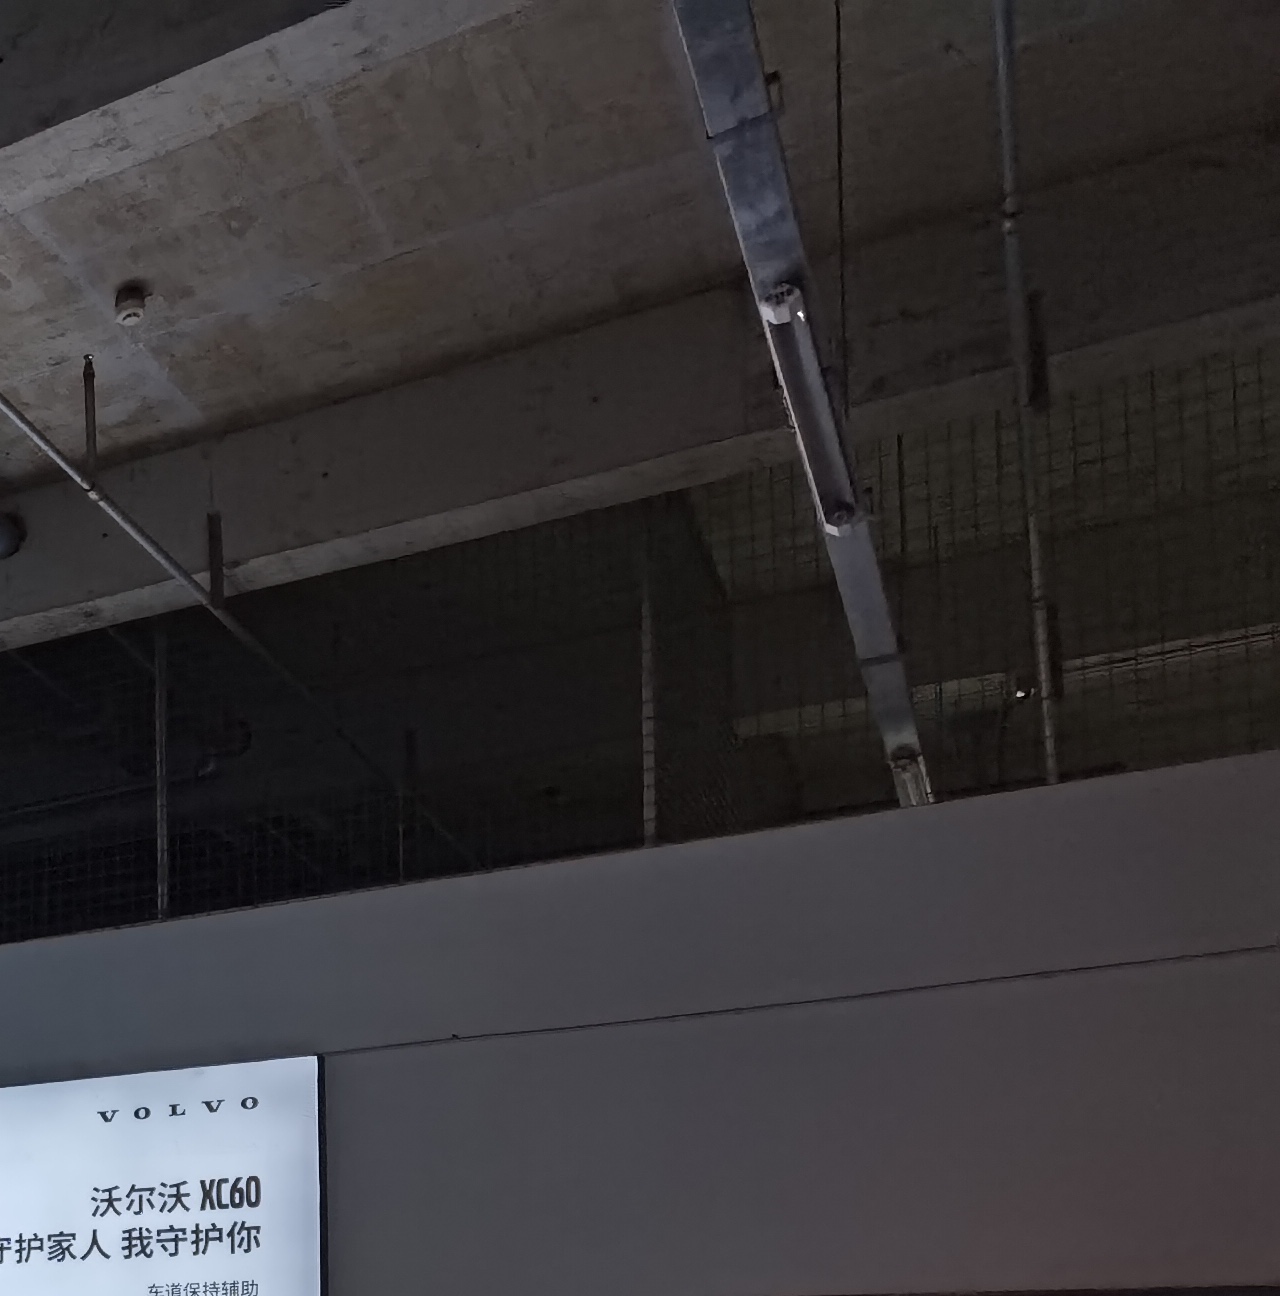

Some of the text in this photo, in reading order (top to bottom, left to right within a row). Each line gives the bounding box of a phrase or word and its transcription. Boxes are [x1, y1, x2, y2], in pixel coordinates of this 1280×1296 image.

[97, 1096, 259, 1123] VOLVO
[91, 1175, 262, 1217] 沃尔沃 XC60
[121, 1221, 262, 1259] 我守护你
